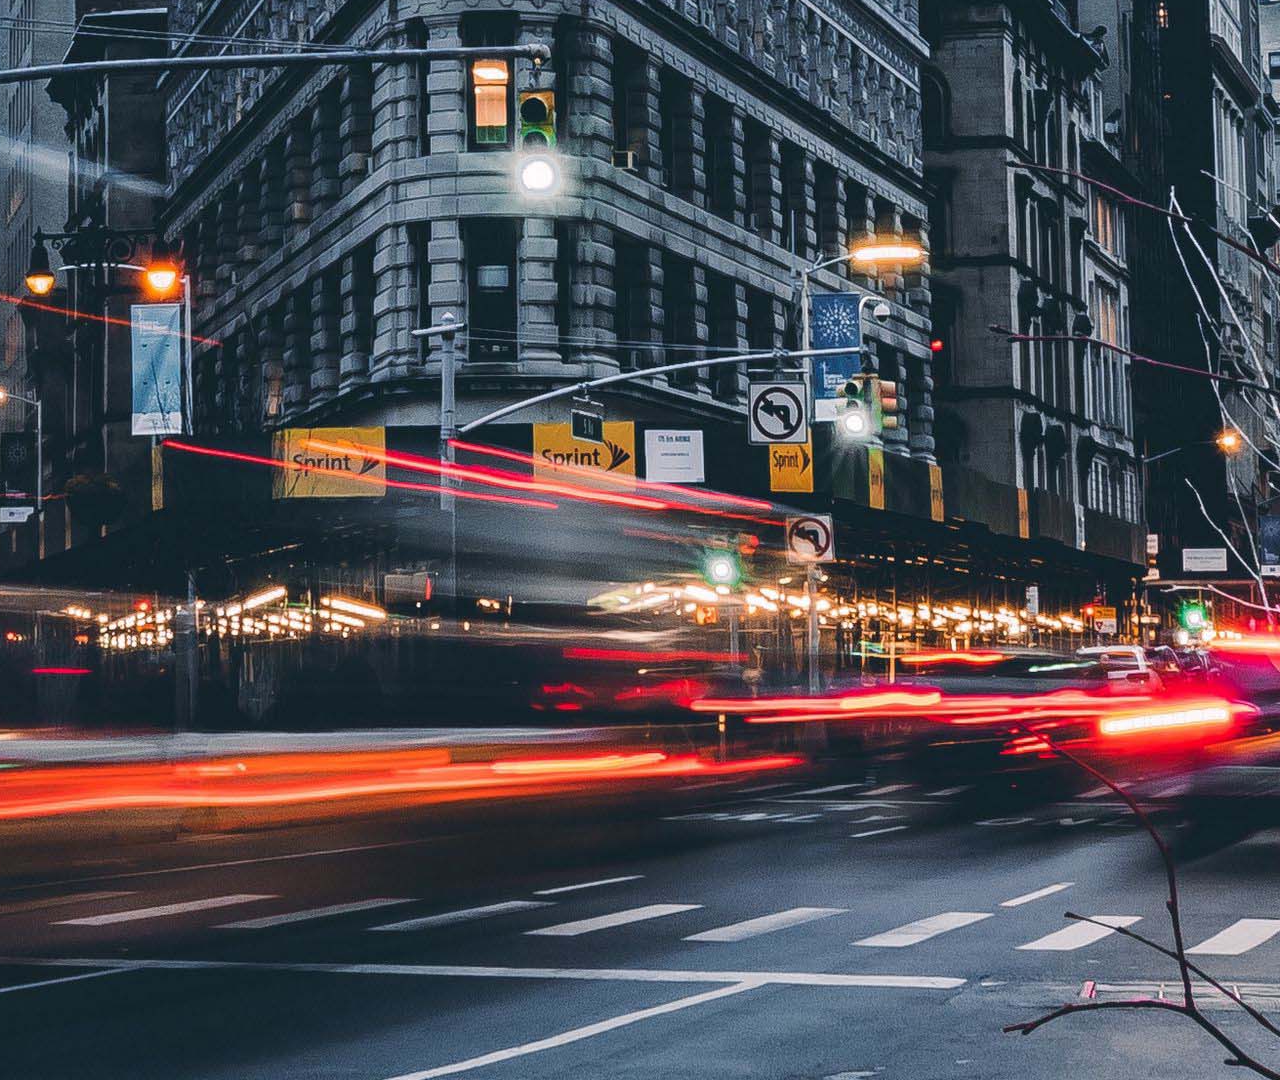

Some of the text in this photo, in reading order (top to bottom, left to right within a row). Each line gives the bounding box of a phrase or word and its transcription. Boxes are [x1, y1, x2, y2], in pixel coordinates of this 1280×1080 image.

[293, 452, 352, 477] Sprint
[542, 448, 601, 472] Sprint
[772, 450, 800, 472] Sprint
